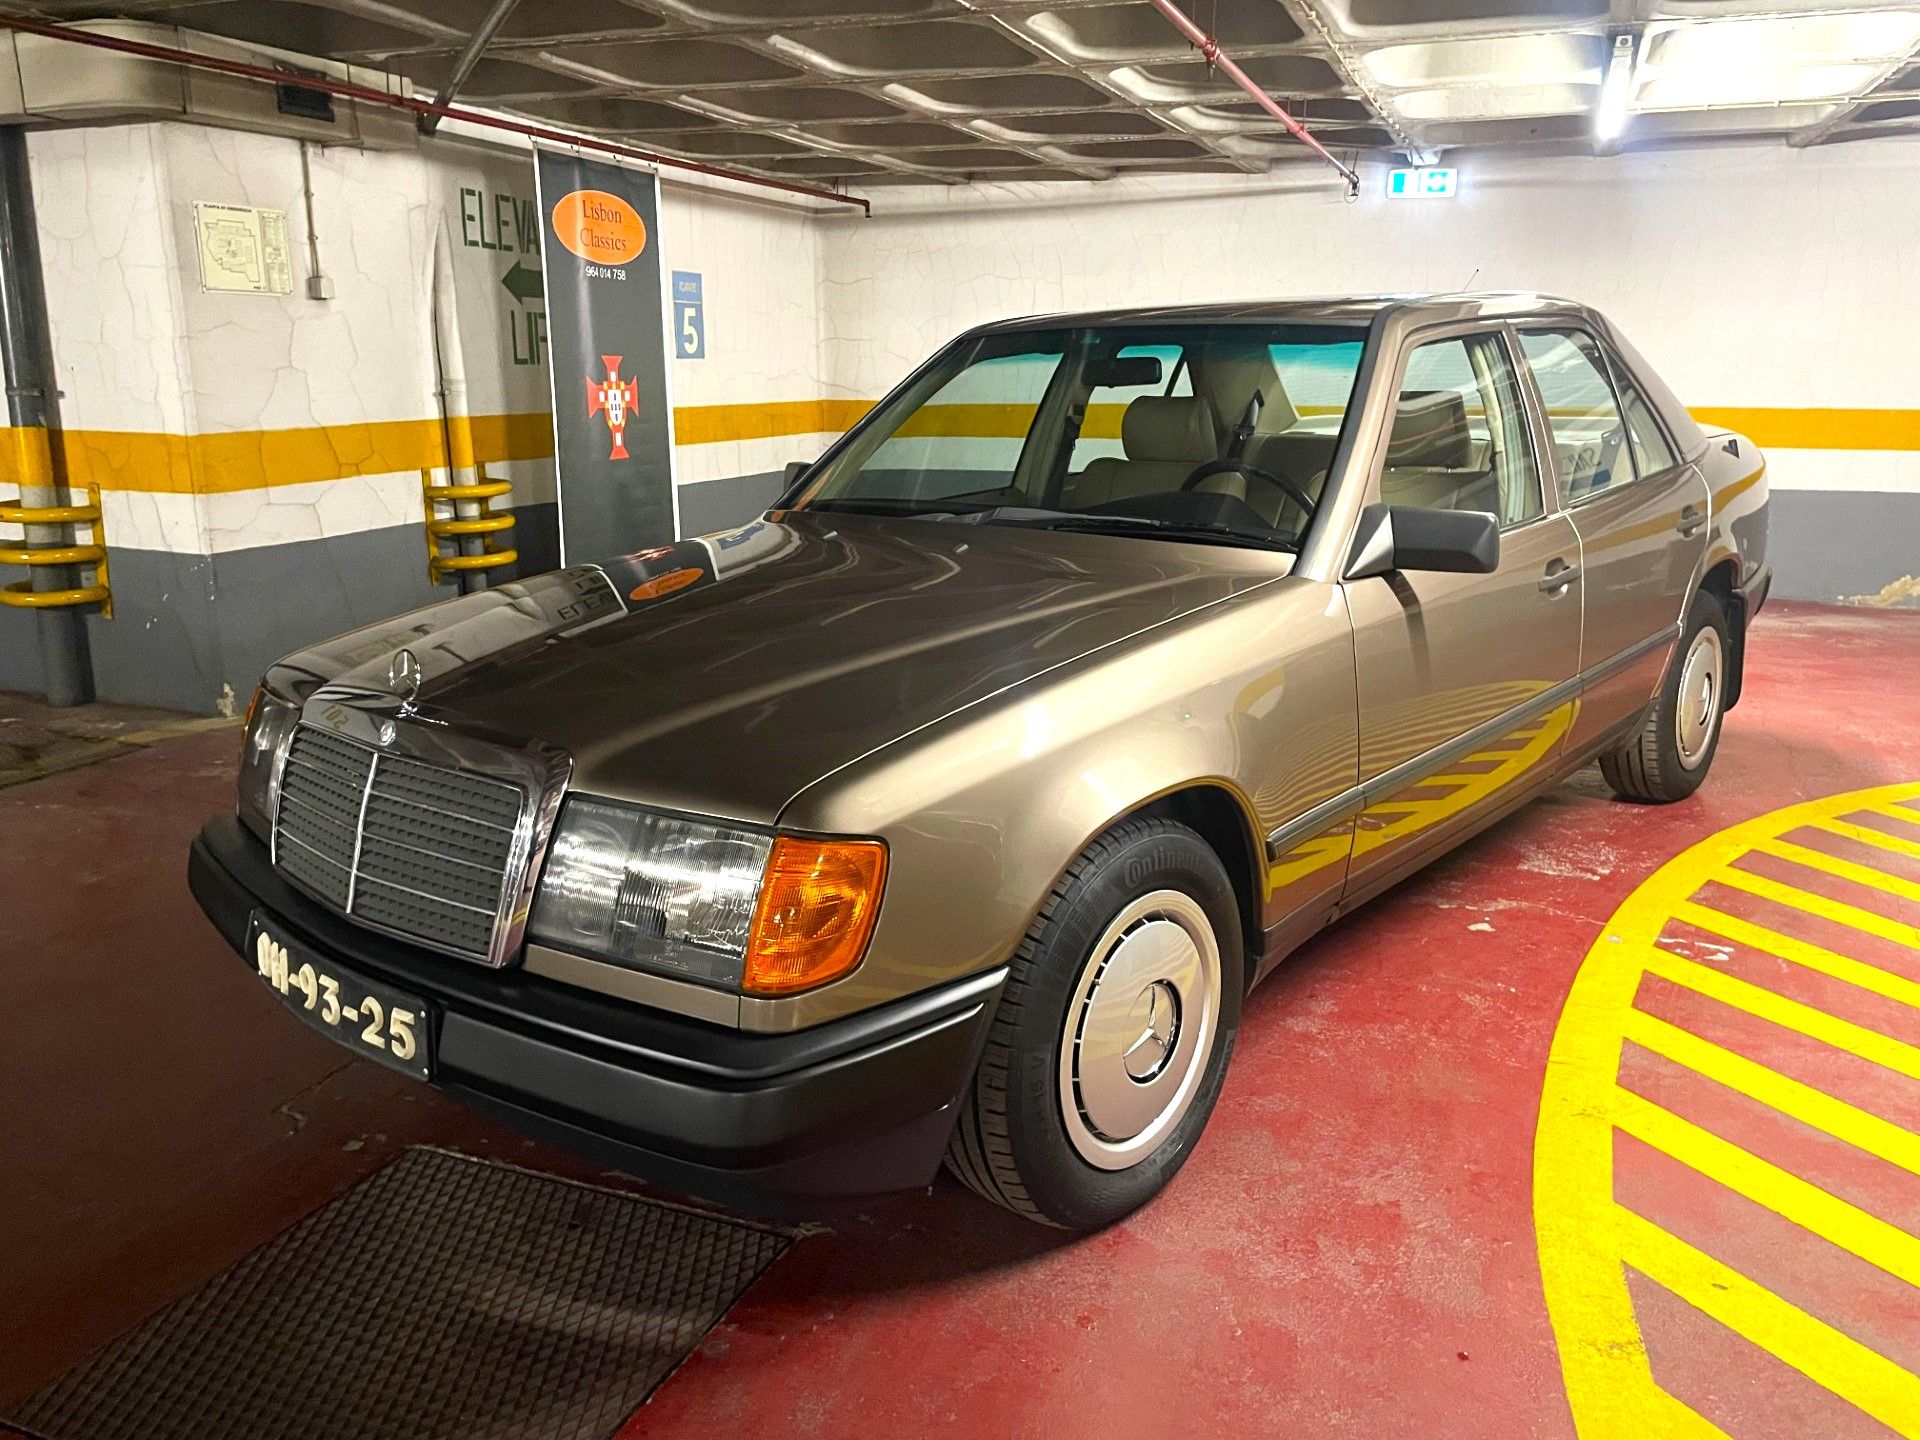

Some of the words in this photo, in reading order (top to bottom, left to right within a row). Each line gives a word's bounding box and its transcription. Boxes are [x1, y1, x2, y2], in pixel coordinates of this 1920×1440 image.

[582, 200, 622, 224] Lisbon
[580, 227, 627, 251] Classics
[585, 266, 599, 277] 964
[600, 267, 611, 279] 014
[612, 269, 626, 280] 758
[683, 307, 699, 354] 5
